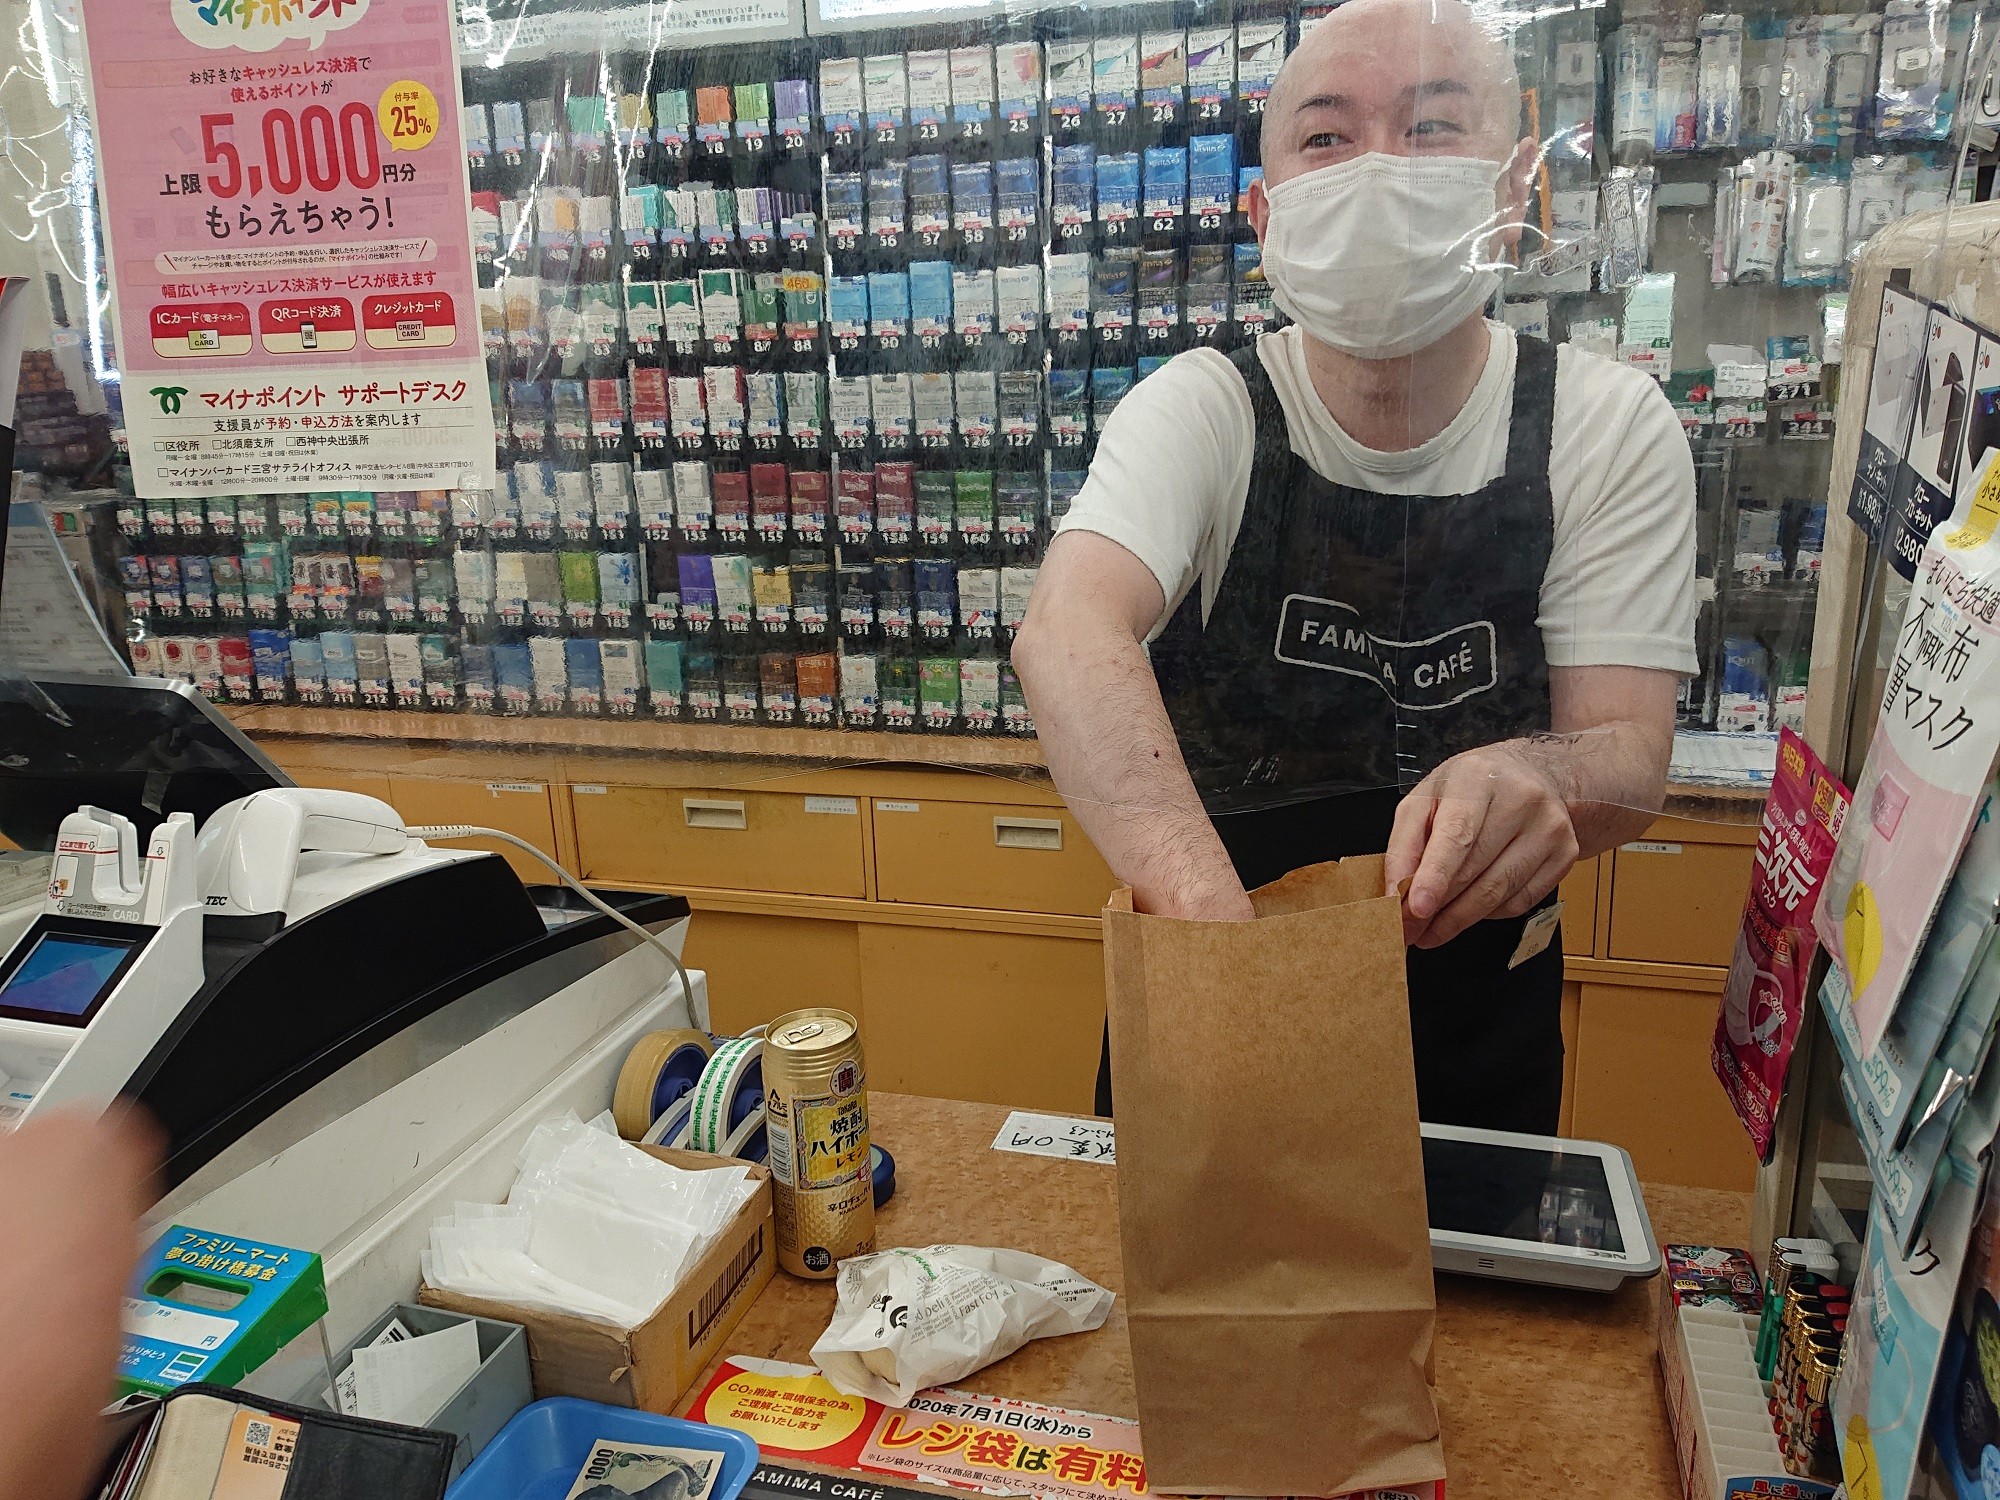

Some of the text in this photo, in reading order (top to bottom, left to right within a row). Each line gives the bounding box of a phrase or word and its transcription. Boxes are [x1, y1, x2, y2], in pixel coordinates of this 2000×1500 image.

[189, 56, 372, 85] お好きなキャッシュレス決済で
[230, 79, 333, 103] 使えるポイントが
[394, 91, 420, 102] 付与率
[1106, 111, 1126, 125] 27
[1201, 104, 1222, 118] 29
[389, 104, 432, 137] 25%
[1061, 116, 1080, 129] 26
[835, 133, 851, 145] 21
[920, 125, 939, 138] 23
[159, 101, 416, 199] 上限 5,000 円分
[746, 138, 763, 150] 19
[785, 136, 803, 148] 20
[206, 196, 395, 239] もらえちゃう!
[1153, 218, 1175, 231] 62
[1199, 215, 1221, 229] 63
[161, 270, 437, 299] 幅広いキャッシュレス決済サービスが使えます
[271, 304, 342, 322] QRコード決済
[374, 300, 442, 315] クレジットカード
[397, 323, 423, 332] CREDIT
[400, 329, 420, 338] CARD
[1103, 329, 1123, 341] 95
[1196, 324, 1217, 337] 97
[1244, 322, 1265, 336] 98
[194, 338, 214, 347] CARD
[199, 379, 468, 410] マイナポイント サポートデスク
[213, 412, 422, 433] 支援員が予約・申込方法を案内します
[165, 434, 370, 452] 区役所 北須磨支所 西神中央出張所
[169, 462, 352, 478] マイナンバーカード三宮サテライトオフィス
[1413, 641, 1473, 689] CAFÉ
[205, 895, 228, 907] TEC
[112, 909, 140, 922] CARD
[830, 1106, 864, 1138] 焼酎
[836, 1148, 863, 1169] レモン
[179, 1233, 290, 1267] ファミリーマート
[805, 1248, 829, 1267] お酒
[1586, 1249, 1628, 1261] NEC
[163, 1246, 279, 1282] 夢の掛け橋募金
[200, 1335, 218, 1347] 円
[737, 1397, 828, 1420] ご理解とご協力を
[729, 1409, 822, 1432] お願いいたします
[903, 1397, 1093, 1439] 020年7月1日(水)から
[584, 1448, 616, 1480] 1000
[752, 1470, 822, 1493] AMIMA
